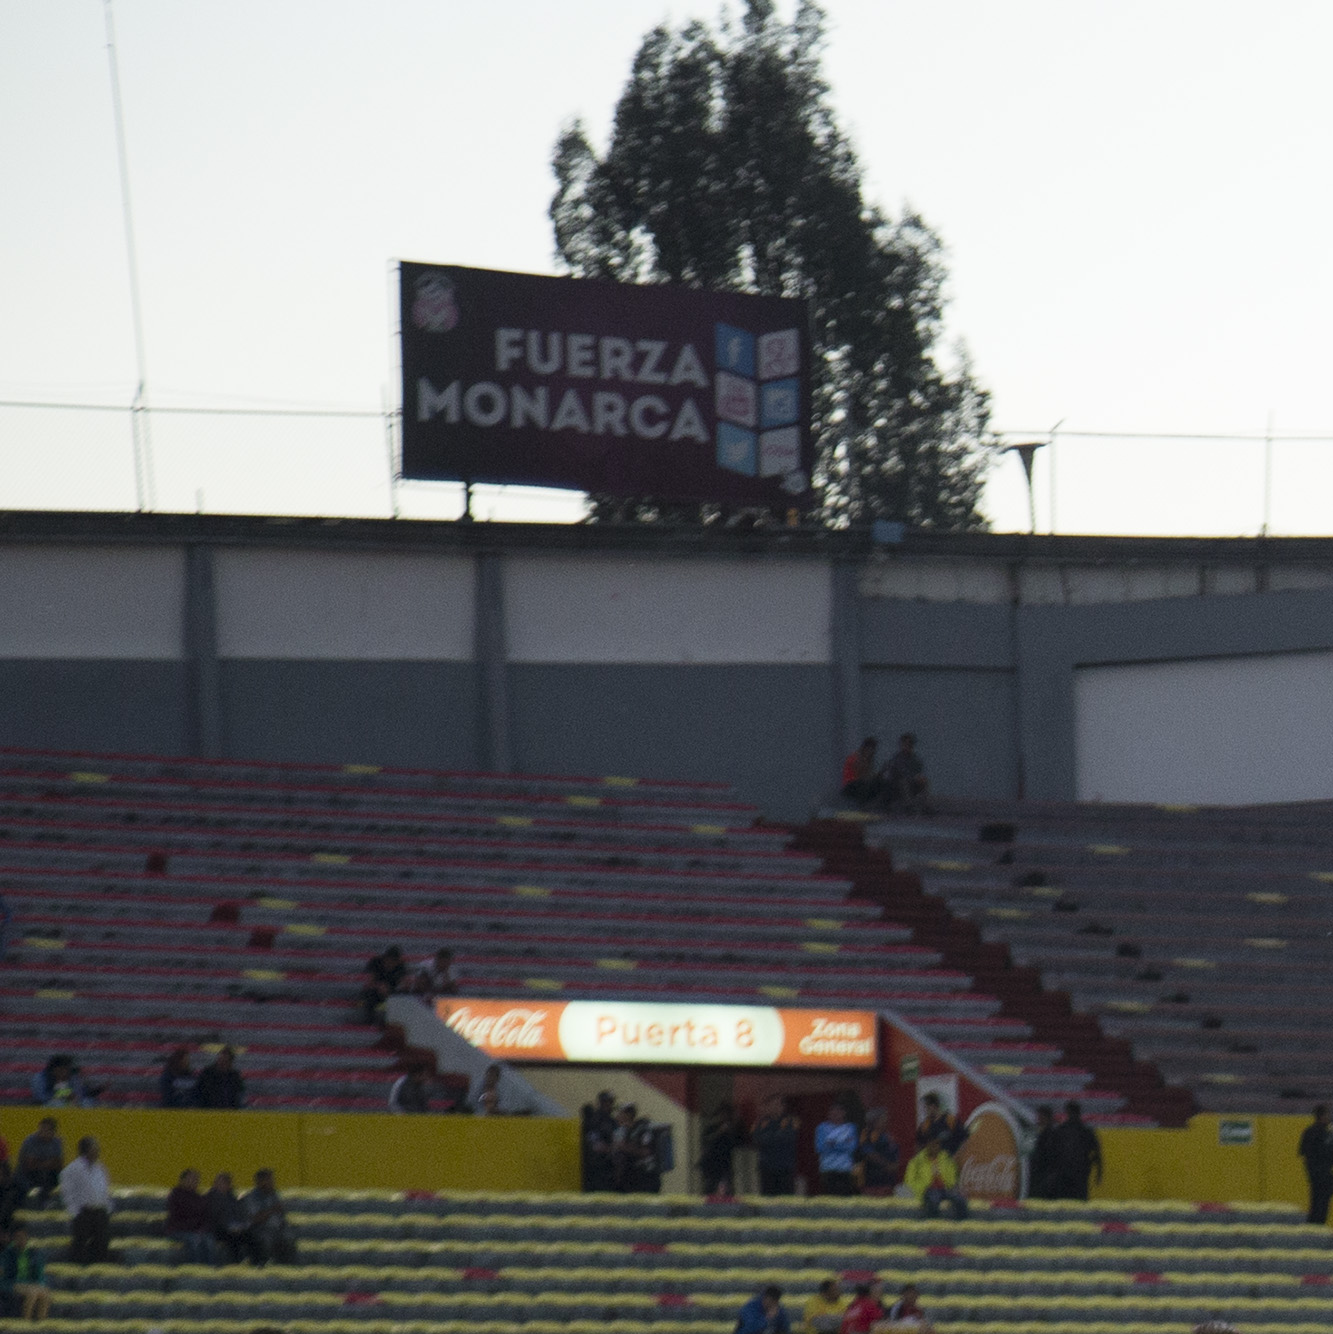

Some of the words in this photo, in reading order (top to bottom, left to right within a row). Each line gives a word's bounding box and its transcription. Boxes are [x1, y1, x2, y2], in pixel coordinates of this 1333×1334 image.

[495, 327, 709, 389] FUERZA
[416, 377, 710, 443] MONARCA
[597, 1016, 717, 1047] Puerta
[734, 1018, 757, 1049] 8
[810, 1018, 861, 1038] Zona
[799, 1035, 874, 1057] General
